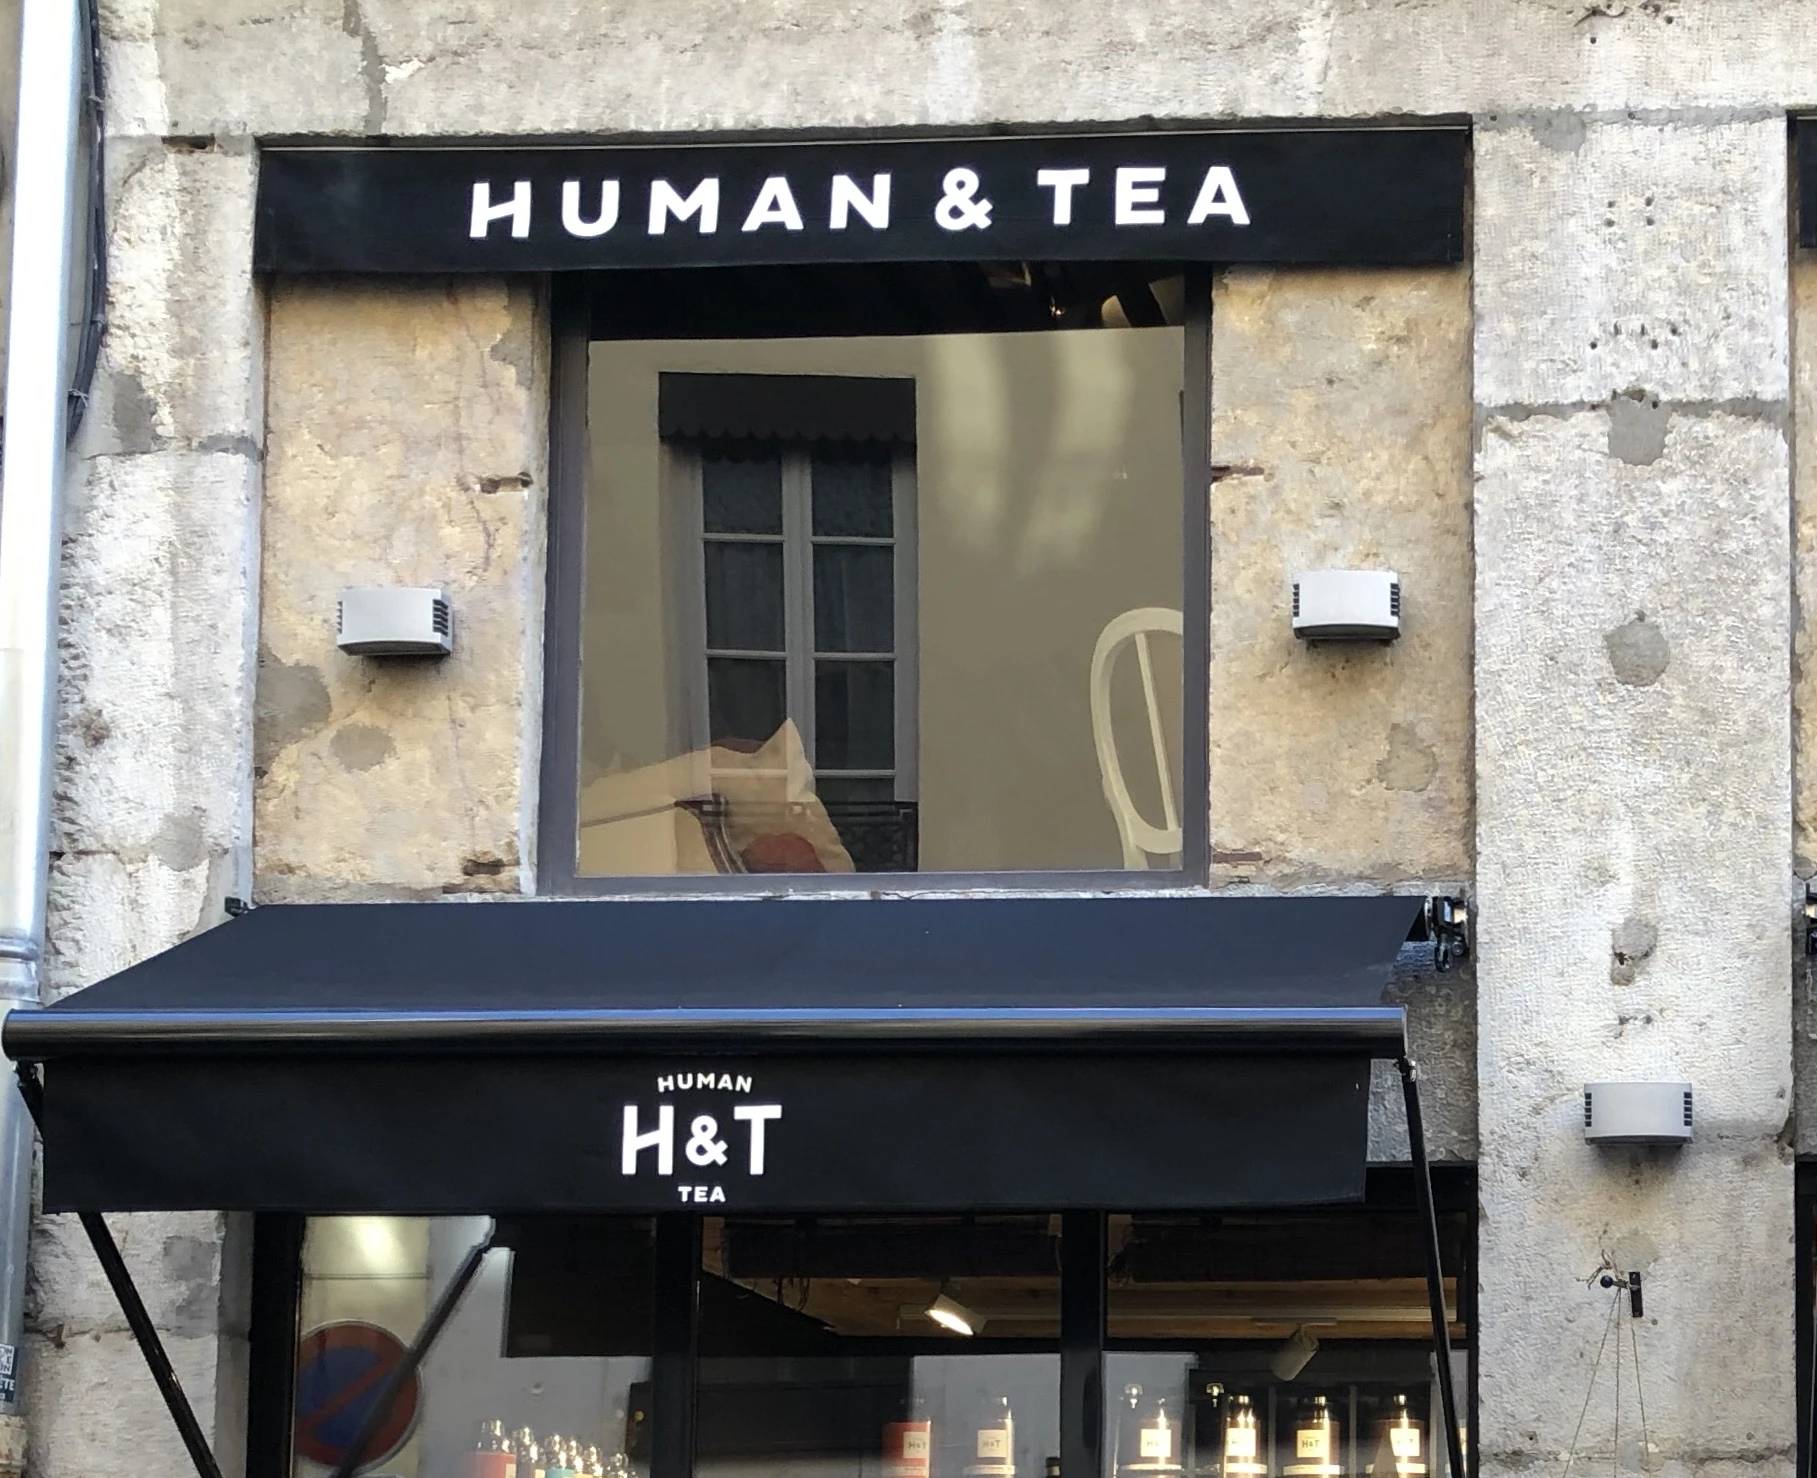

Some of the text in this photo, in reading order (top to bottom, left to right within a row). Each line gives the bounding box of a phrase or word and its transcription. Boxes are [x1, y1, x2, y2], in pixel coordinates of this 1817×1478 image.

[469, 165, 1251, 239] HUMAN & TEA
[657, 1072, 753, 1093] HUMAN
[621, 1104, 783, 1176] H&T
[677, 1185, 726, 1203] TEA
